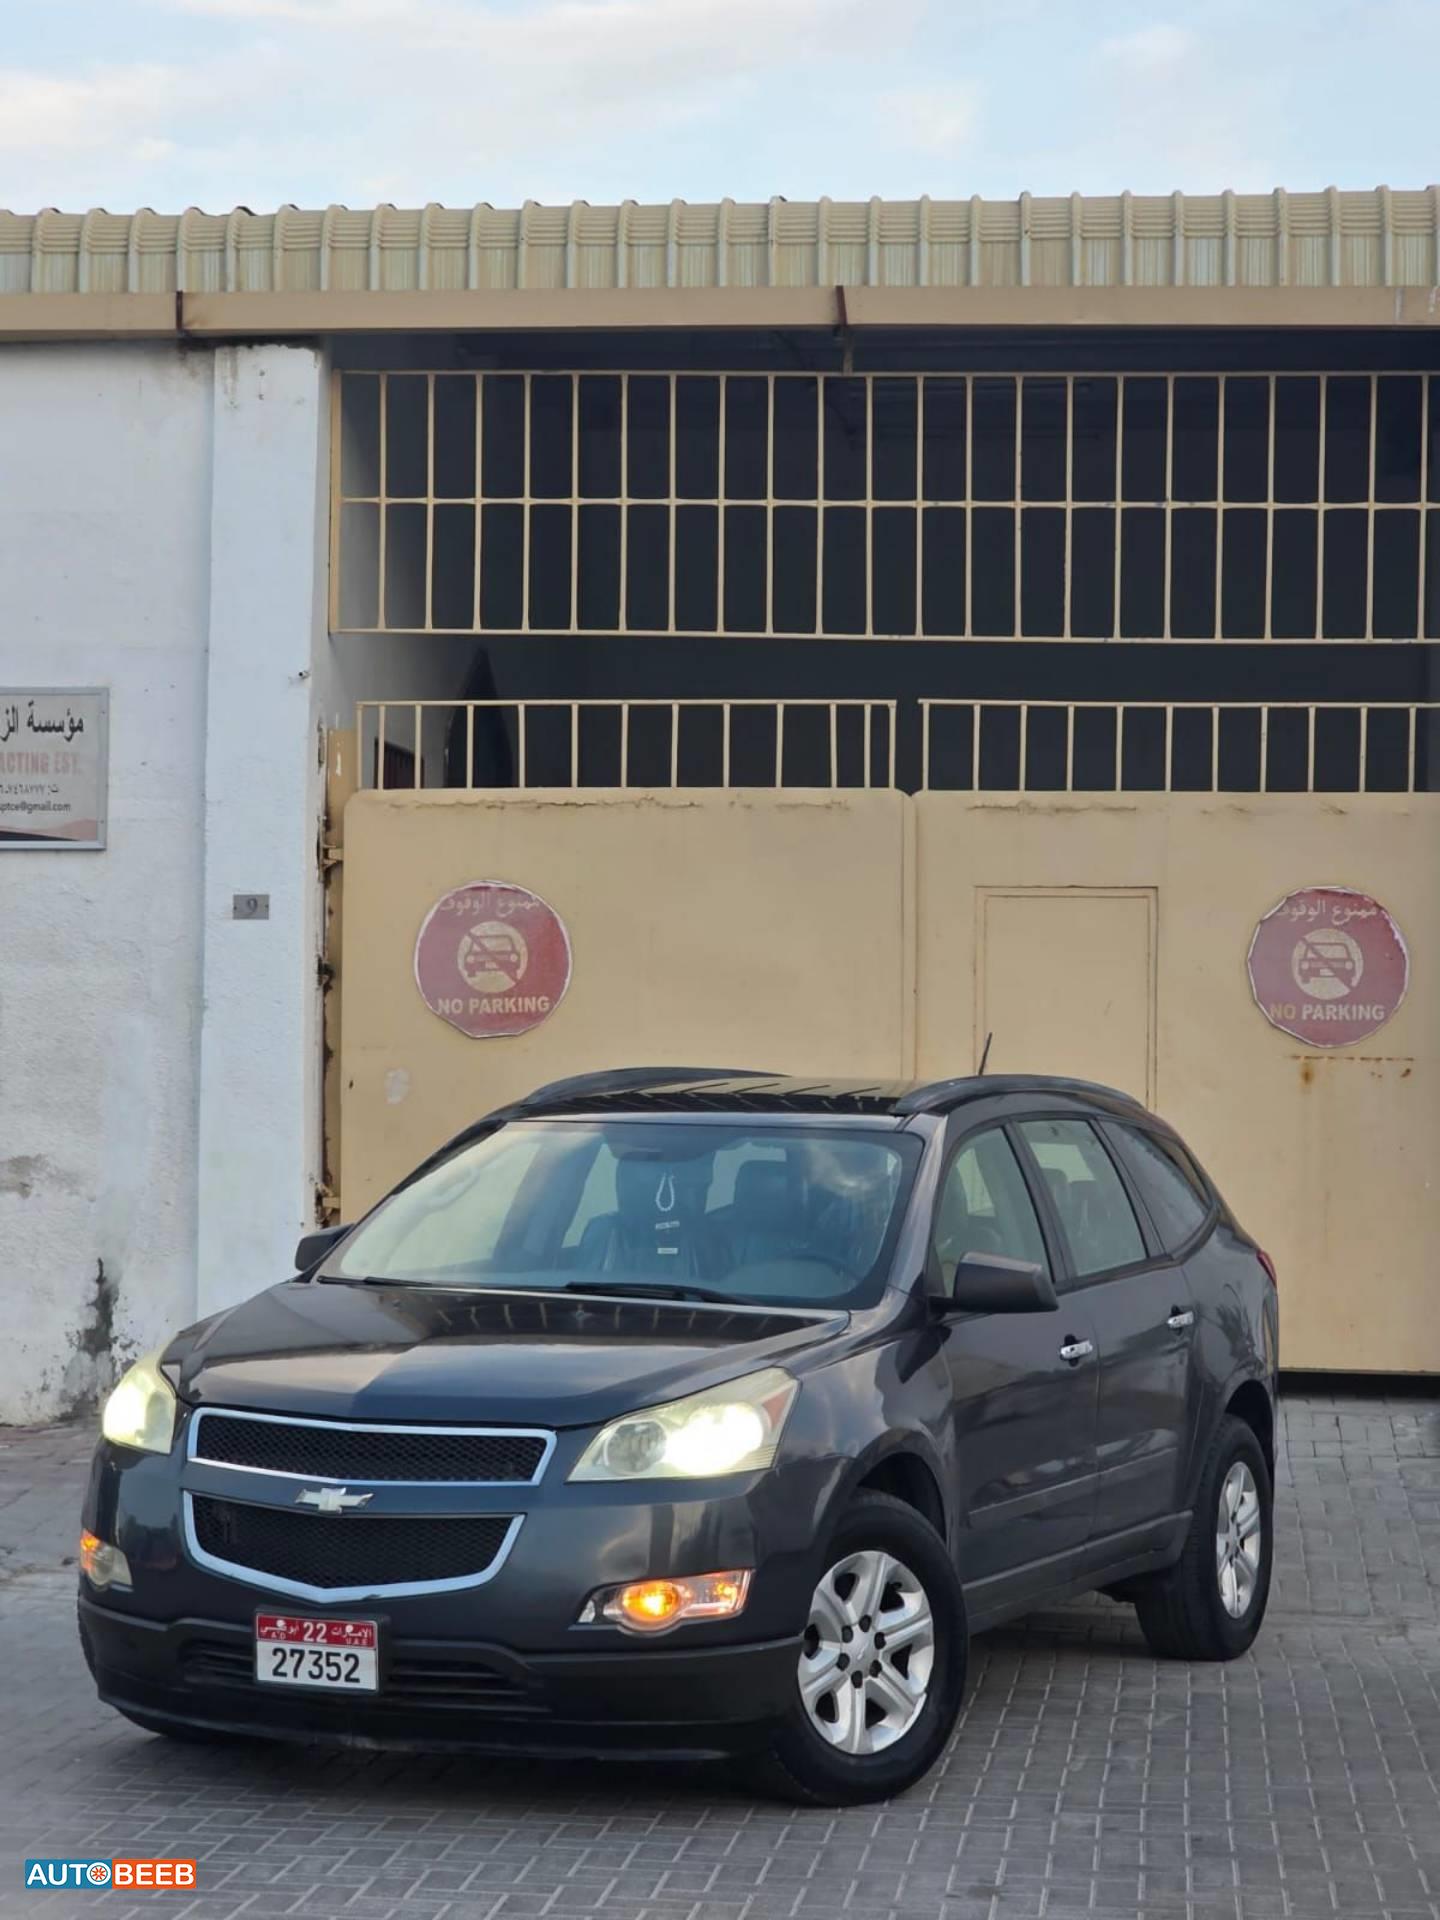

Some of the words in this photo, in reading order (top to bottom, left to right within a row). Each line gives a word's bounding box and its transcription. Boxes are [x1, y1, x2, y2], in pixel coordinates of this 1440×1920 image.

[27, 699, 84, 742] مؤسسة
[440, 891, 491, 916] الوقوف
[1276, 899, 1326, 922] الوقوف
[1331, 903, 1378, 925] ممنوع
[438, 998, 463, 1014] NO
[469, 996, 550, 1015] PARKING
[1270, 1004, 1296, 1019] NO
[1302, 1004, 1385, 1020] PARKING
[303, 1622, 327, 1643] 22
[272, 1648, 360, 1683] 27352
